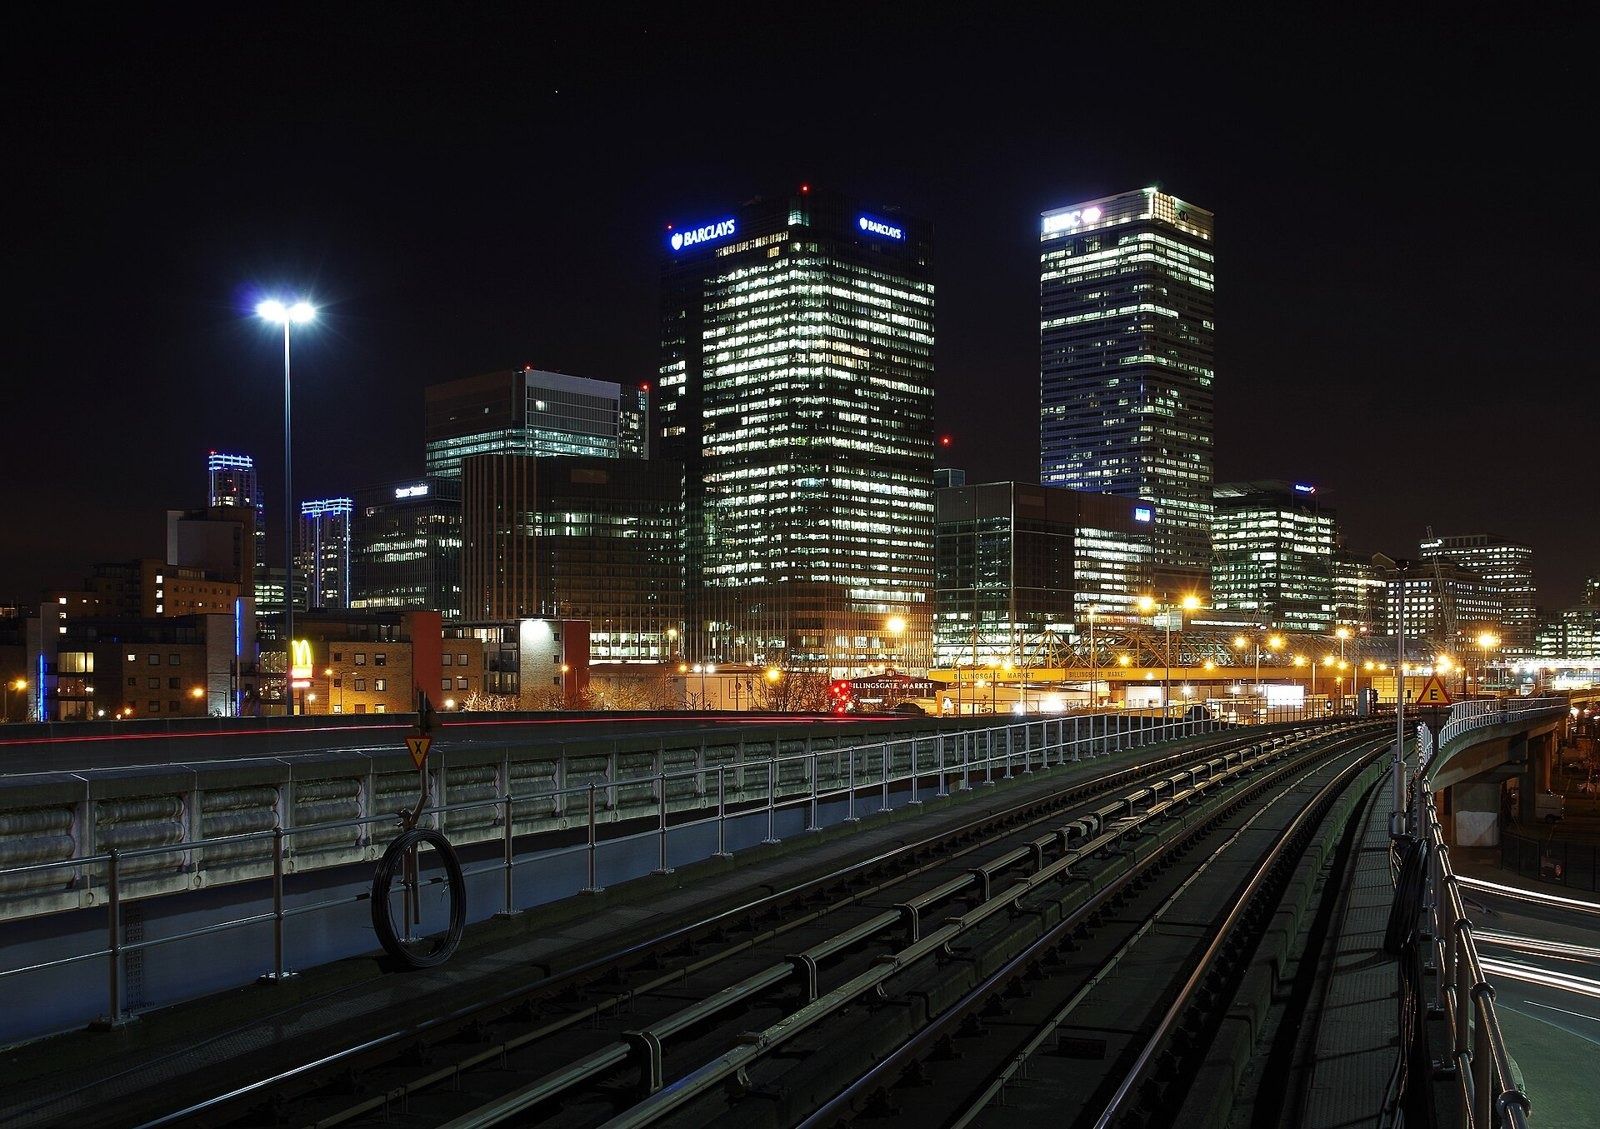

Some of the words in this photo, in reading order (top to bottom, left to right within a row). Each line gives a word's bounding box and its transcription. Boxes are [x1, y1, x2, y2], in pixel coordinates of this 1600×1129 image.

[683, 218, 735, 247] BARCLAYS
[868, 220, 902, 239] BARCLAYS
[953, 672, 1001, 680] BLLINGSGAE
[1430, 689, 1439, 700] E
[414, 740, 423, 754] X
